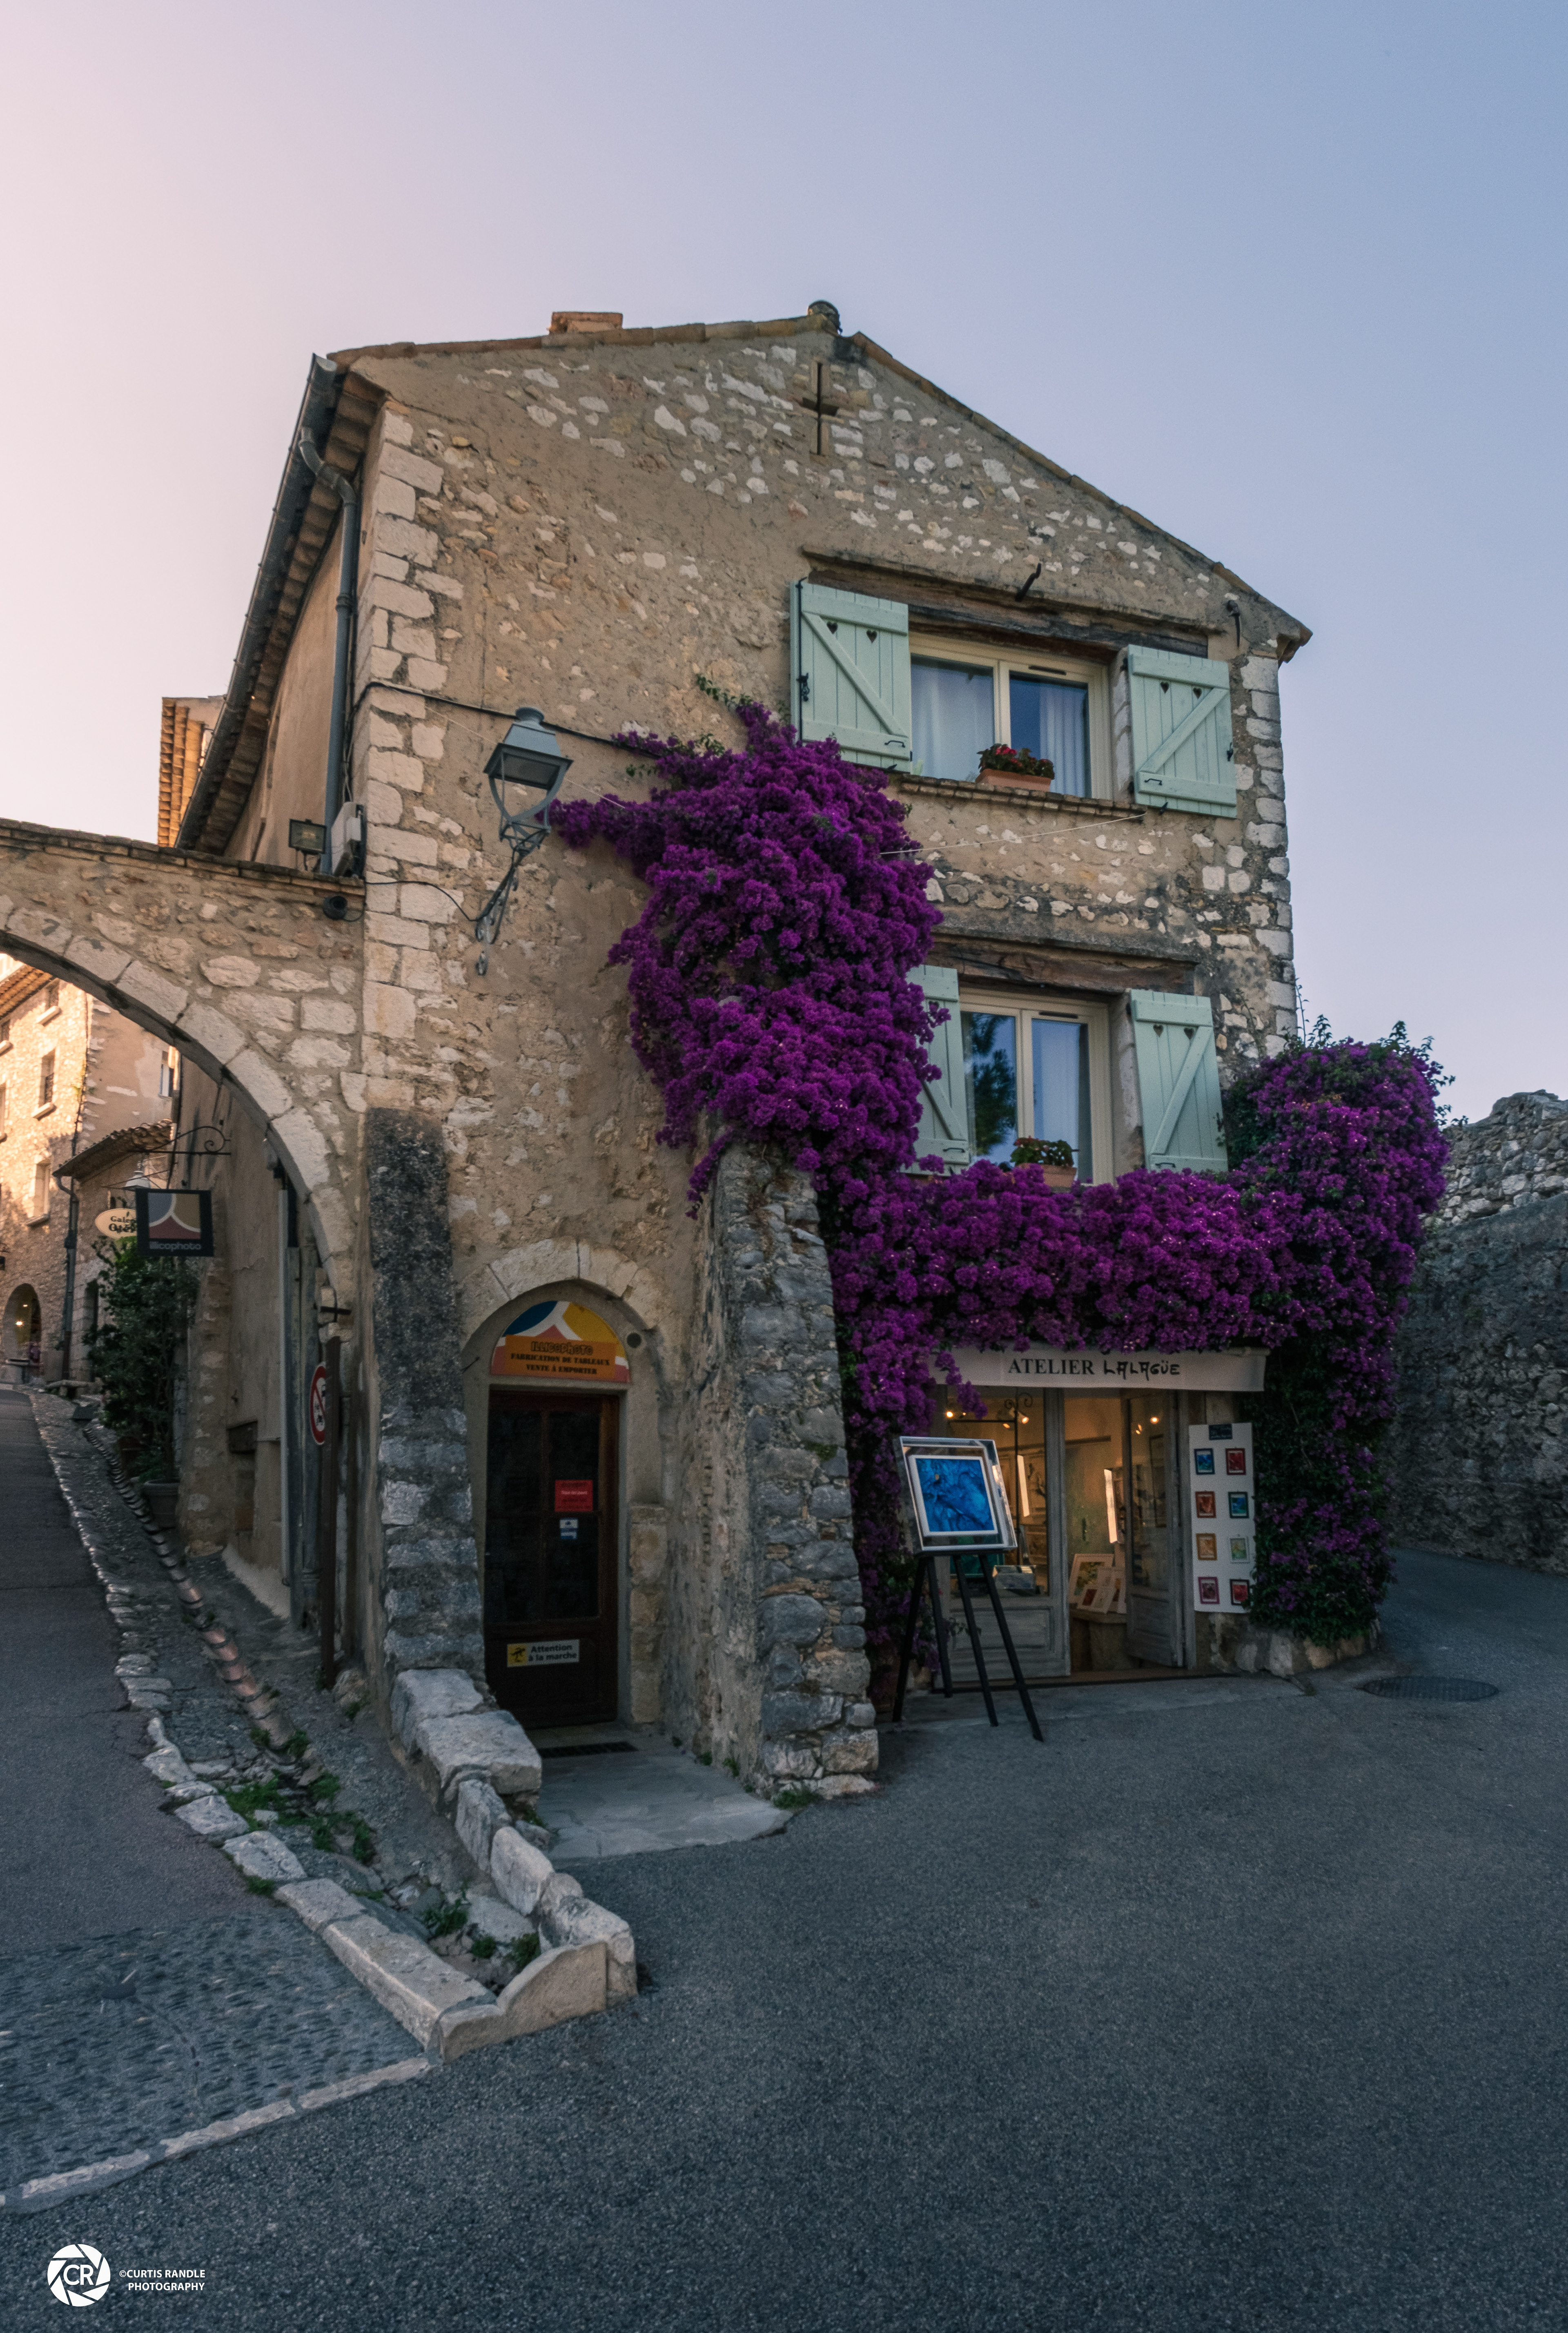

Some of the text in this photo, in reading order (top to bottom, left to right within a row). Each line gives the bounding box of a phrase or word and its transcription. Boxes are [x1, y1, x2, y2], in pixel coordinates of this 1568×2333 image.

[510, 1353, 560, 1362] FABRICATION
[551, 1364, 556, 1372] À
[558, 1366, 597, 1374] EMPORTER
[1008, 1358, 1181, 1381] ATELIER LALAGÜE
[531, 1644, 572, 1653] Attention
